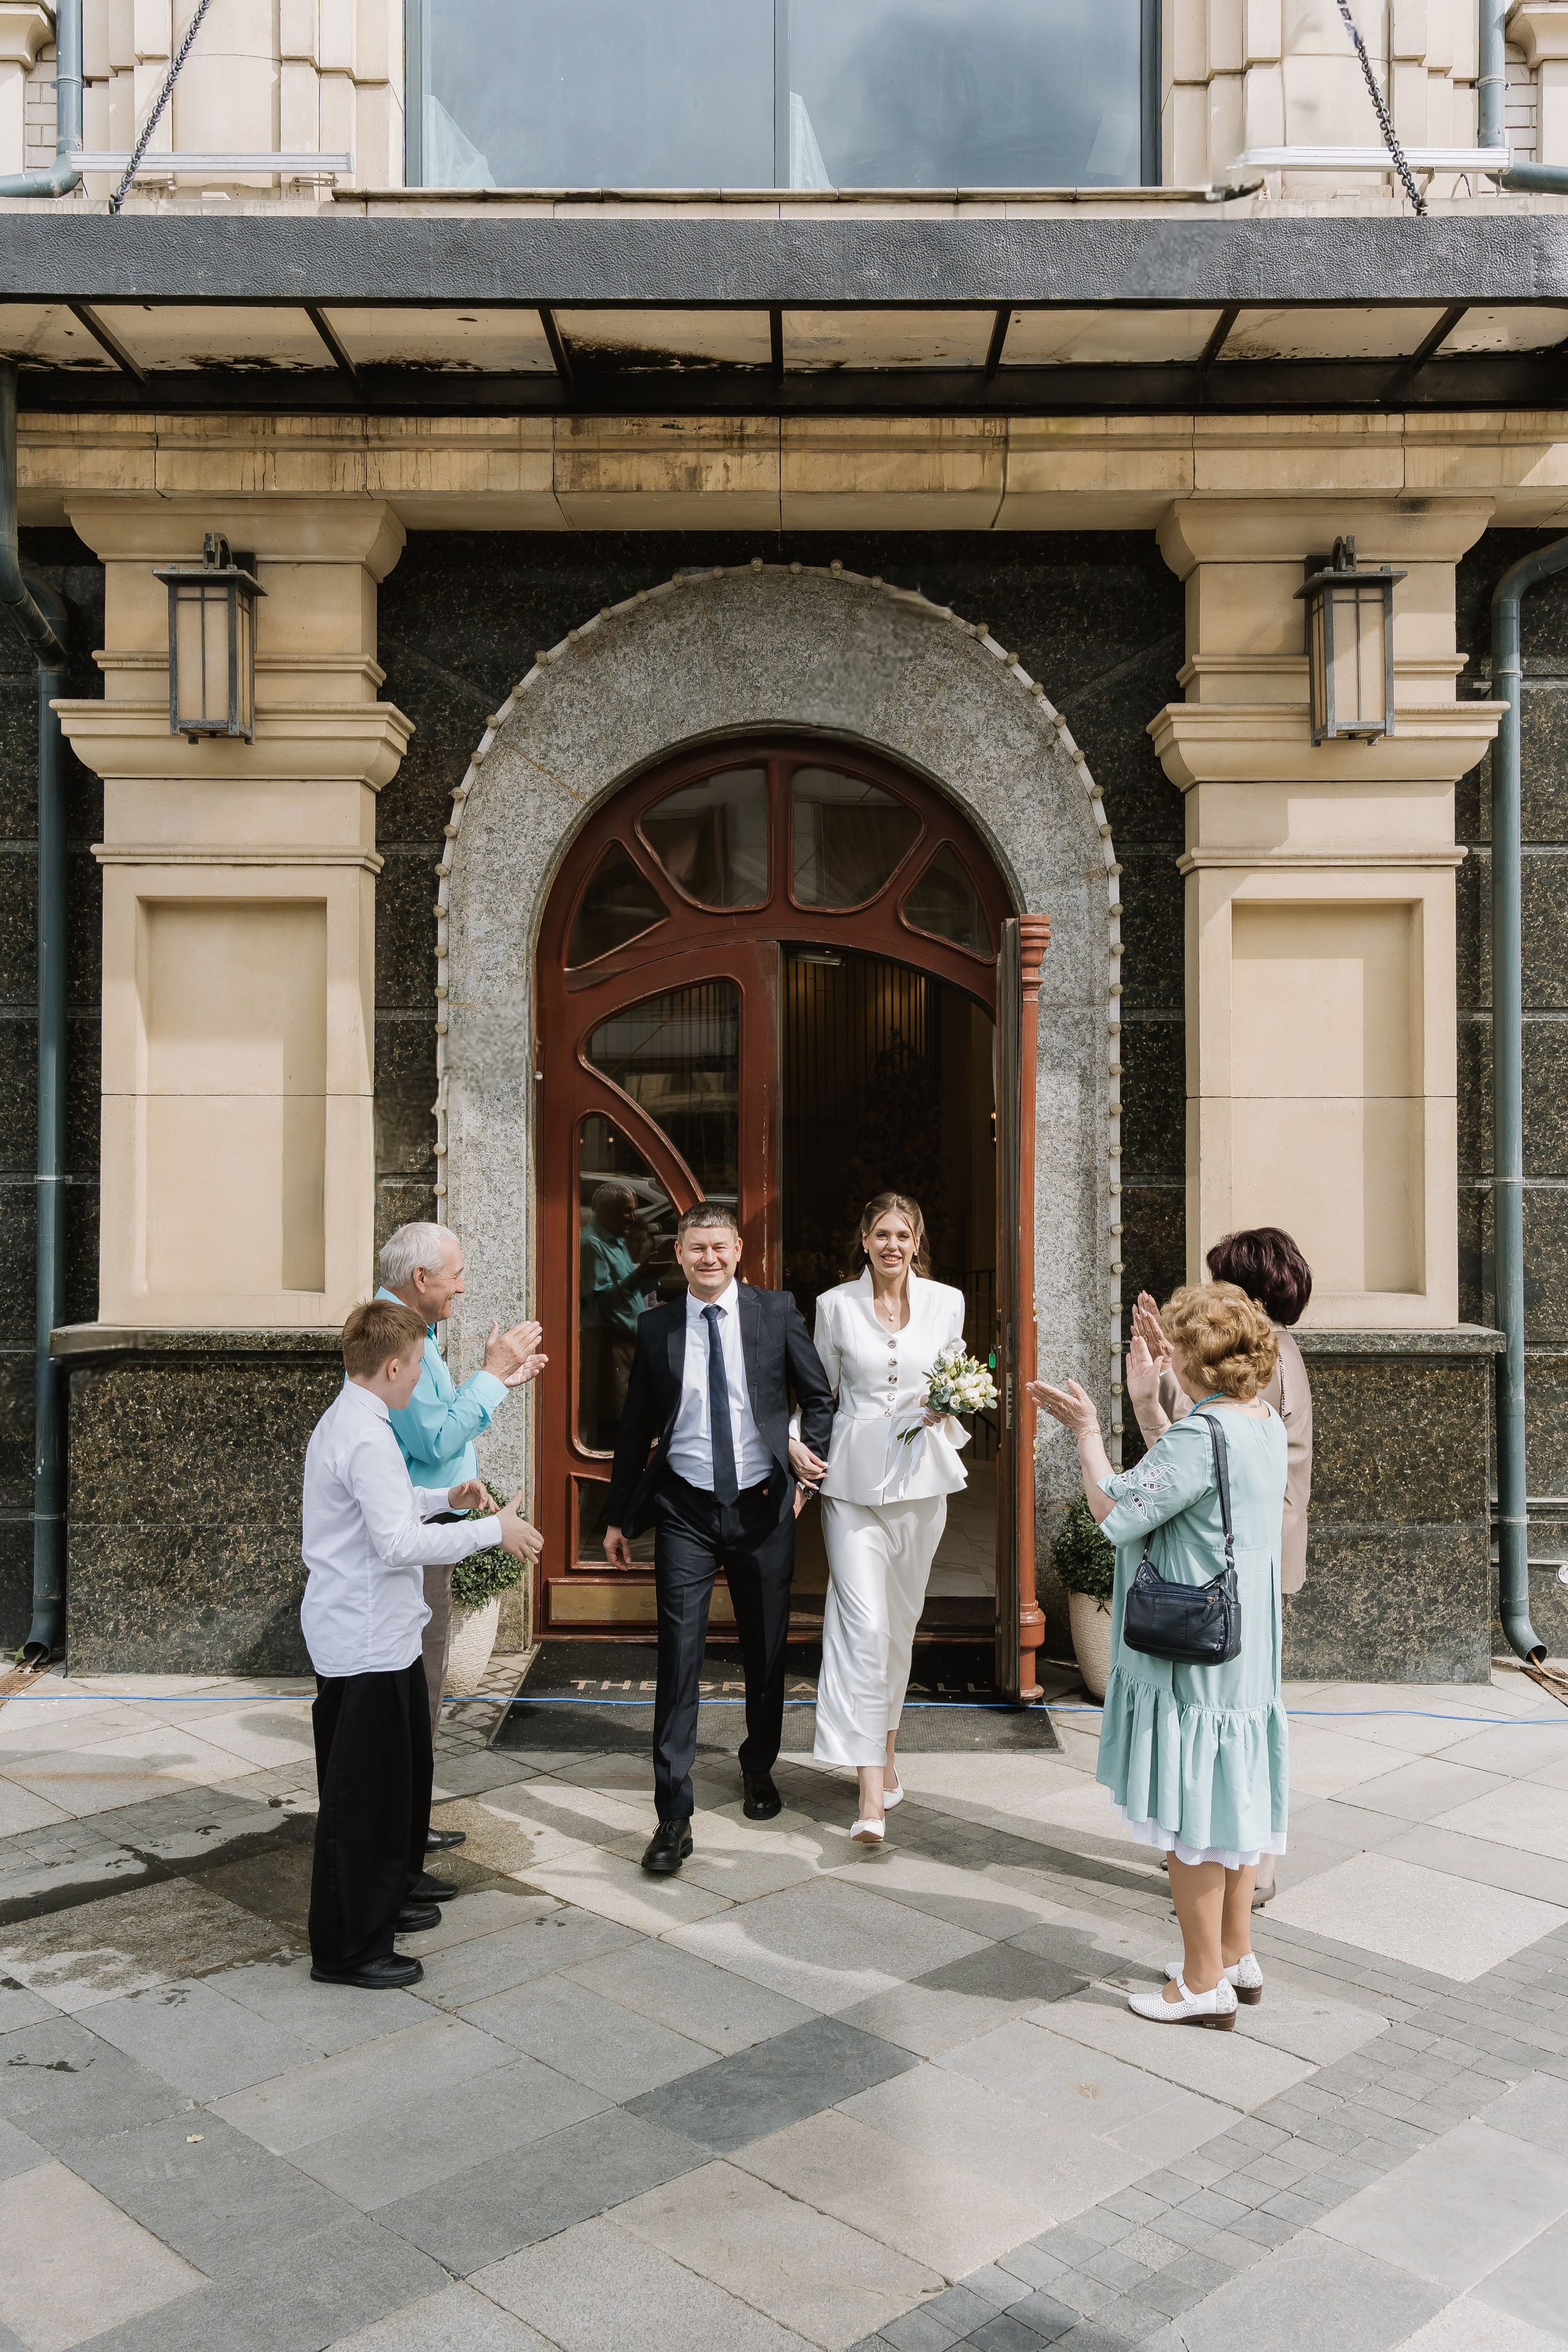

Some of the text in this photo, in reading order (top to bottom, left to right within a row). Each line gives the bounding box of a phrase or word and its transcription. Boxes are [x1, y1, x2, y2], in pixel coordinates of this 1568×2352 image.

[570, 1680, 992, 1692] THE GRA ALL
